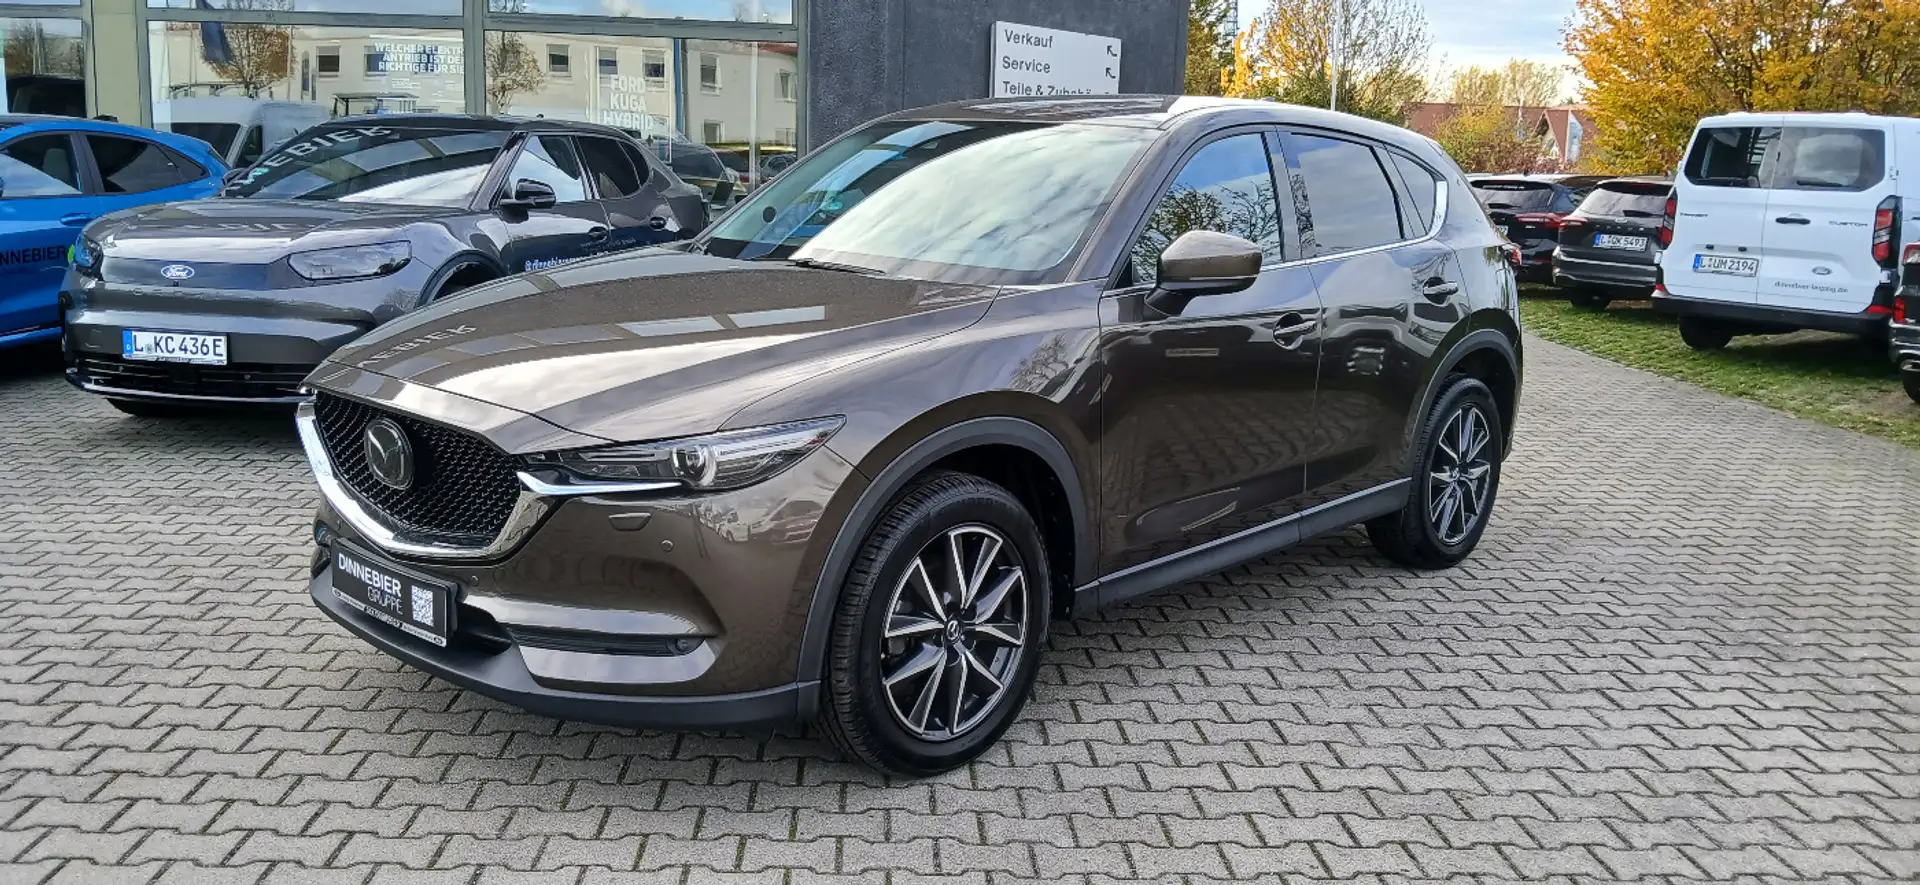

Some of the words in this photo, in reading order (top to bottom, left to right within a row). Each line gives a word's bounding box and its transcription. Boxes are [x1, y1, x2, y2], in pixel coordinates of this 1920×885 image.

[1004, 28, 1053, 48] Verkauf
[375, 42, 424, 54] WELCHER
[378, 60, 426, 73] RICHTIGE
[383, 51, 428, 63] ANTRIEB
[429, 53, 446, 65] IST
[1002, 55, 1051, 74] Service
[611, 75, 645, 93] FORD
[1003, 80, 1032, 96] Teile
[1036, 84, 1043, 96] &
[610, 91, 648, 113] KUGA
[603, 110, 653, 130] HYBRID
[133, 334, 144, 353] L
[153, 335, 175, 355] KC
[338, 552, 402, 598] DINNEBIER
[367, 586, 403, 615] GRUPPE
